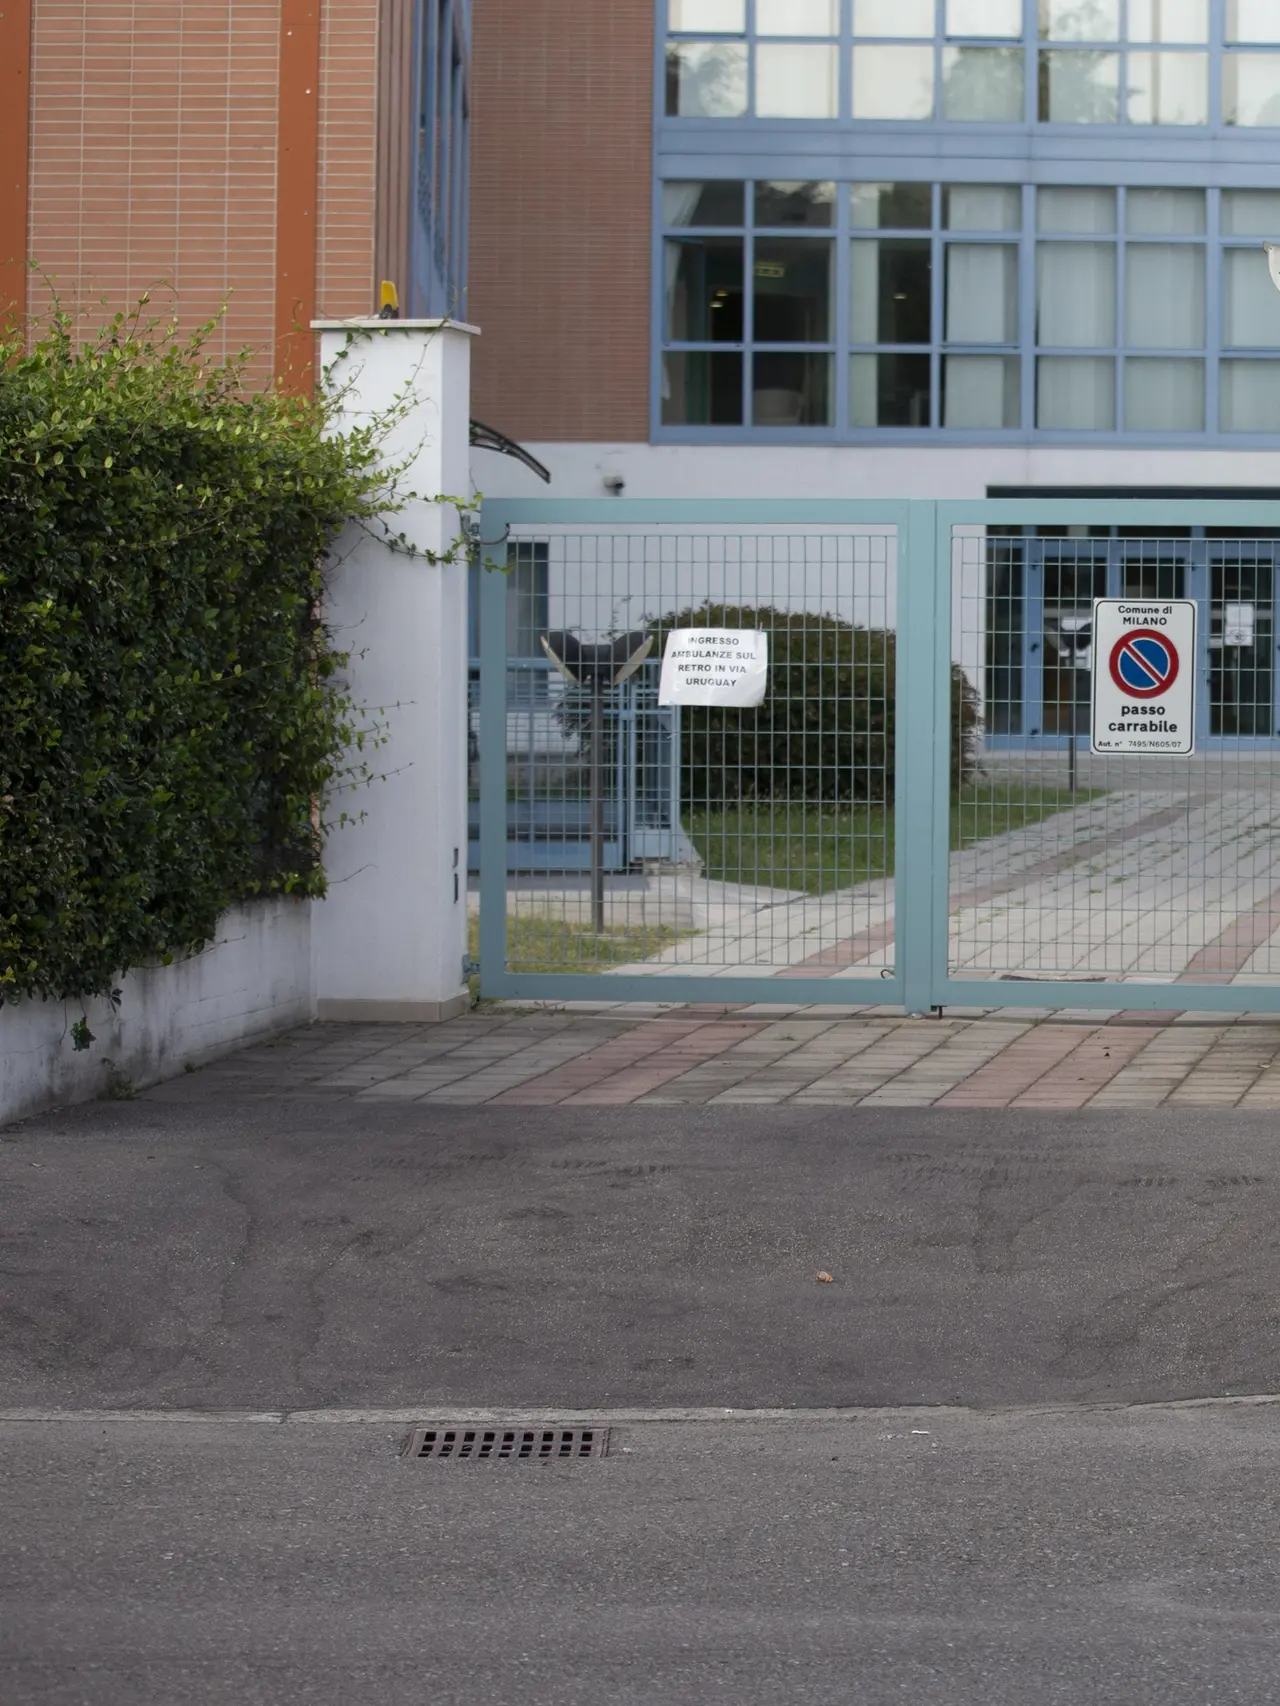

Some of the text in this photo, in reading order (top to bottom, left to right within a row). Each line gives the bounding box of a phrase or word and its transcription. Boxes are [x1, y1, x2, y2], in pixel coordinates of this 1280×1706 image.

[1118, 605, 1173, 615] Comune di
[1122, 617, 1168, 626] MILANO
[687, 636, 740, 646] INGRESSO
[670, 650, 757, 660] AMBULANZE SUL
[677, 664, 747, 674] RETRO IN VIA
[685, 678, 737, 687] URUGUAY
[1120, 705, 1166, 717] passo
[1108, 720, 1178, 733] carrabile
